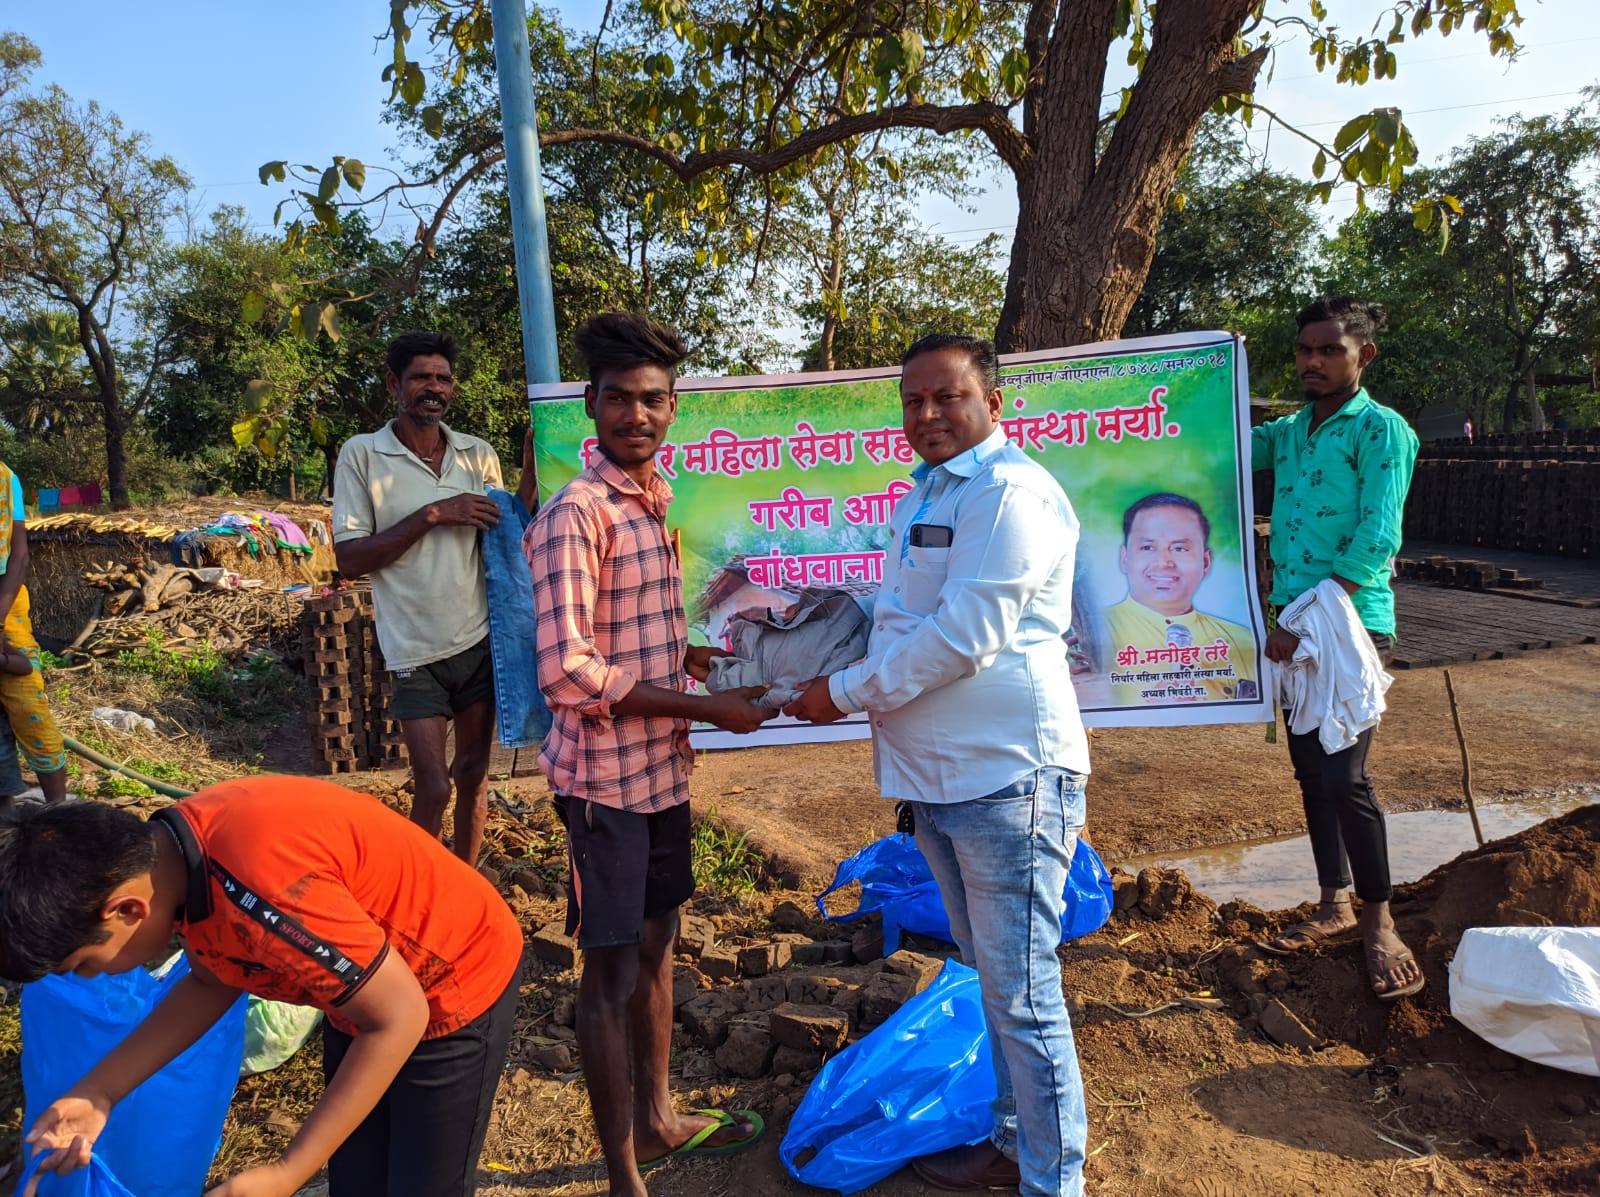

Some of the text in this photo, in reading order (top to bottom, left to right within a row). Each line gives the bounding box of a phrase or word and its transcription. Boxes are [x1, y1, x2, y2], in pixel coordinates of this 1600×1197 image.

[683, 431, 781, 476] महिला
[789, 423, 855, 468] सेवा
[1095, 387, 1180, 441] मर्या.
[749, 488, 833, 530] गरीब
[1204, 639, 1229, 662] तरे
[1136, 670, 1160, 682] महिला
[1162, 668, 1192, 681] सहकारी
[1141, 689, 1166, 699] अध्यक्ष
[280, 921, 316, 949] SPORT
